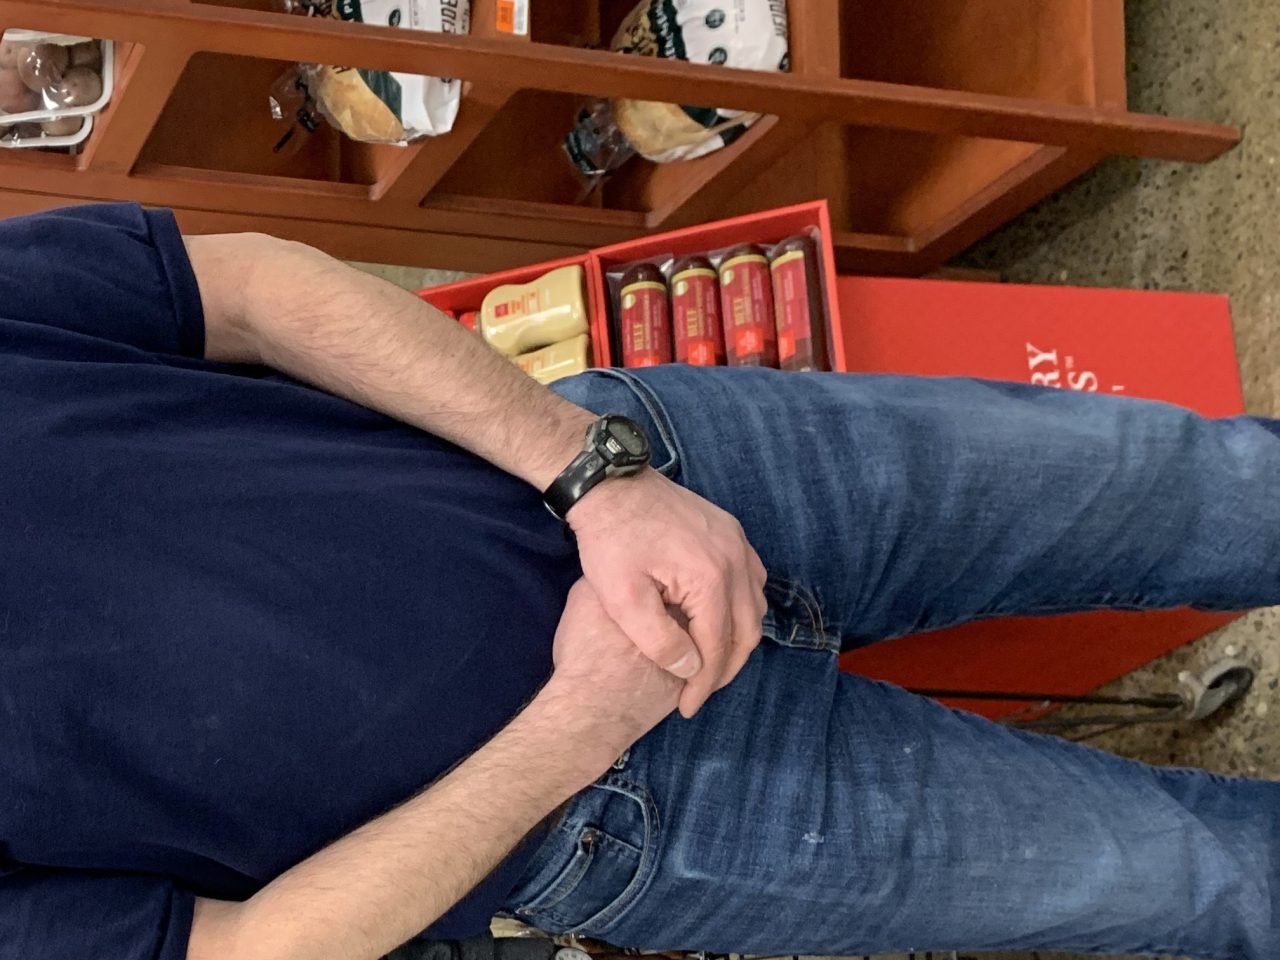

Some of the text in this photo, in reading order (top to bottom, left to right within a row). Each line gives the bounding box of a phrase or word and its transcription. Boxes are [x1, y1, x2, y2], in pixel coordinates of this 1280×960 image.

[686, 307, 698, 337] BEEF
[733, 296, 745, 326] BEEF
[633, 321, 644, 352] BEEF
